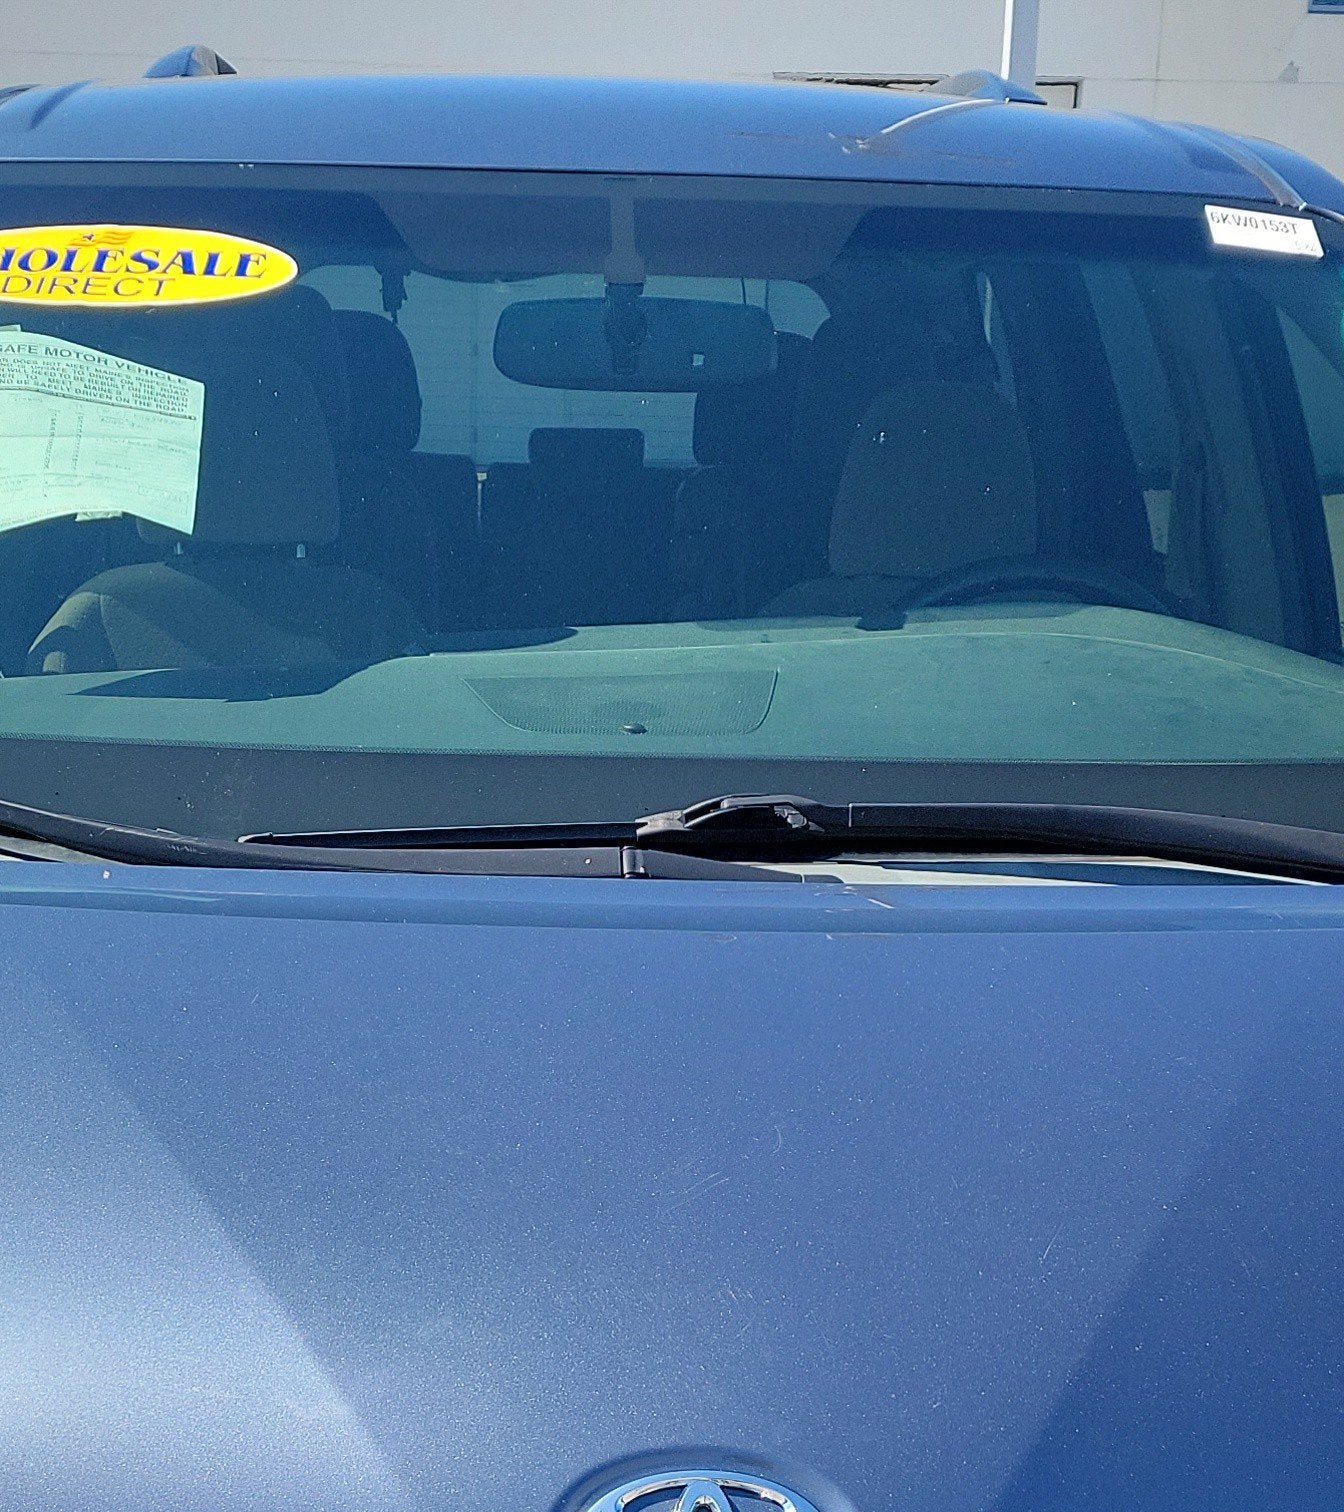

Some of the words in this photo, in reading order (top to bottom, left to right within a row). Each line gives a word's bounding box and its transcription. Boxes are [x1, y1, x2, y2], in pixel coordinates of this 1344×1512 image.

[1210, 210, 1298, 235] 6KW0153T
[0, 275, 177, 298] DIRECT
[31, 369, 57, 378] NEED
[44, 346, 109, 366] MOTOR
[115, 360, 189, 387] VEHICLE
[115, 395, 131, 404] ON
[133, 399, 153, 408] THE
[131, 391, 189, 409] INSPECTION
